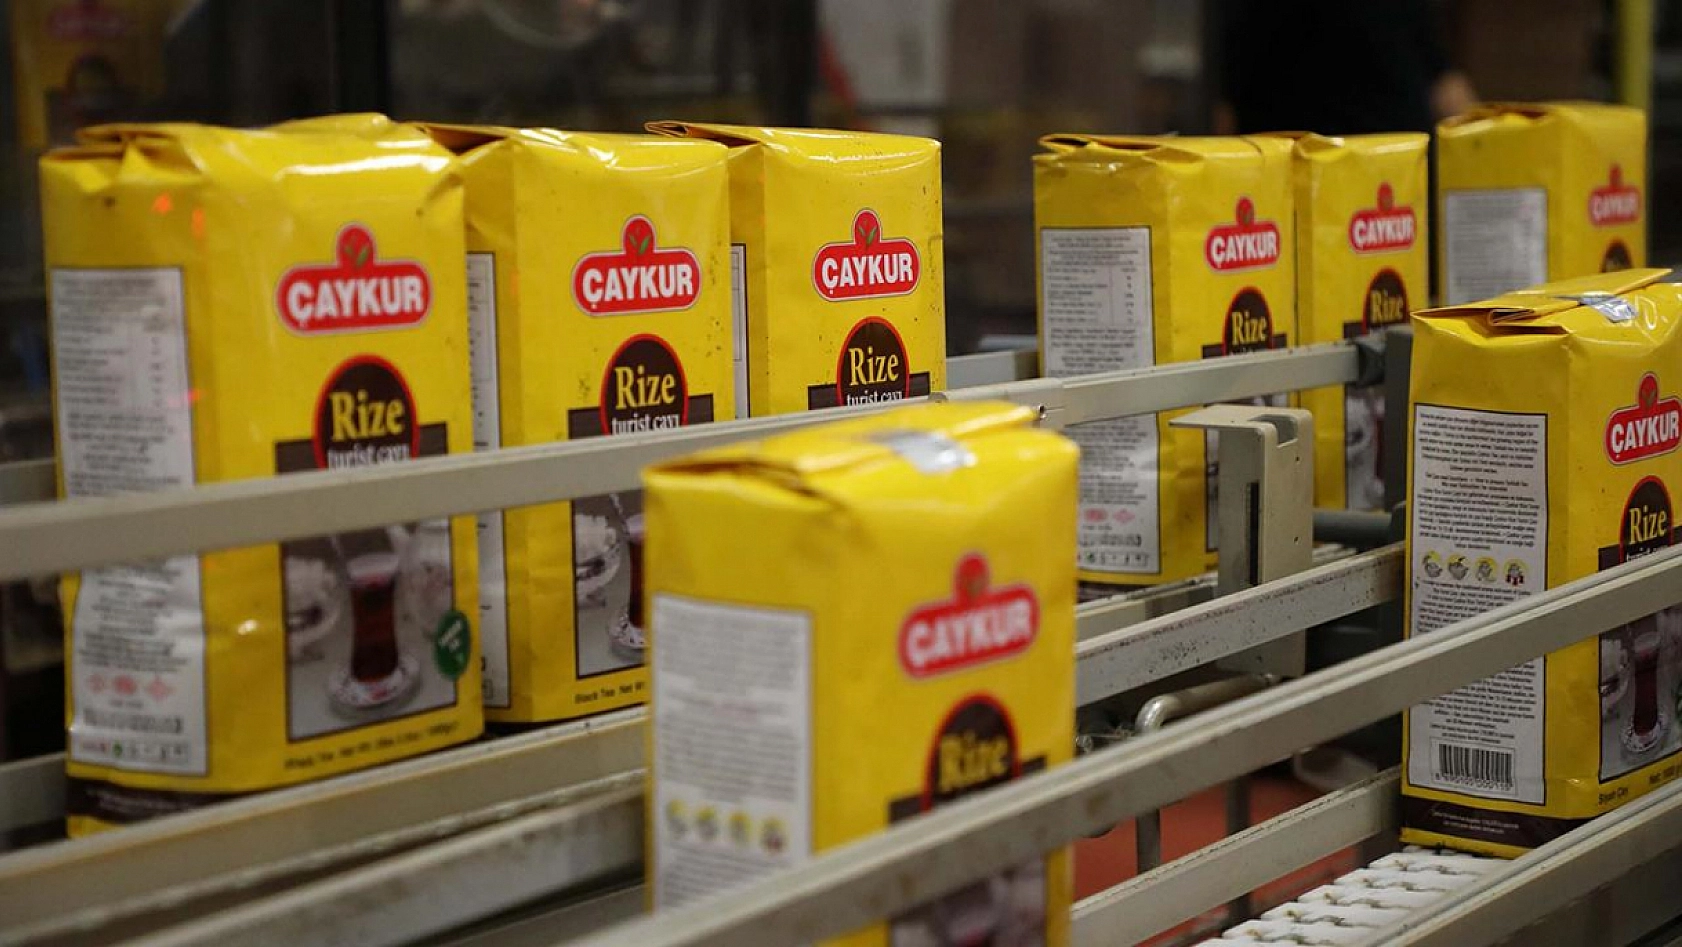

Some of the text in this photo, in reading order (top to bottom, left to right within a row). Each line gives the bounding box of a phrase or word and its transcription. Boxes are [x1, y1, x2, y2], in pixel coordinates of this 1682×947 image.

[1210, 231, 1277, 269] ÇAYKUR
[1354, 215, 1413, 249] ÇAYKUR
[582, 264, 693, 310] ÇAYKUR
[821, 253, 914, 295] ÇAYKUR
[287, 275, 425, 329] ÇAYKUR
[1371, 288, 1404, 323] Rize
[1231, 311, 1268, 345] Rize
[848, 346, 899, 387] Rize
[614, 365, 675, 411] Rize
[329, 389, 405, 442] Rize
[1611, 410, 1680, 458] ÇAYKUR
[1629, 504, 1667, 545] Rize
